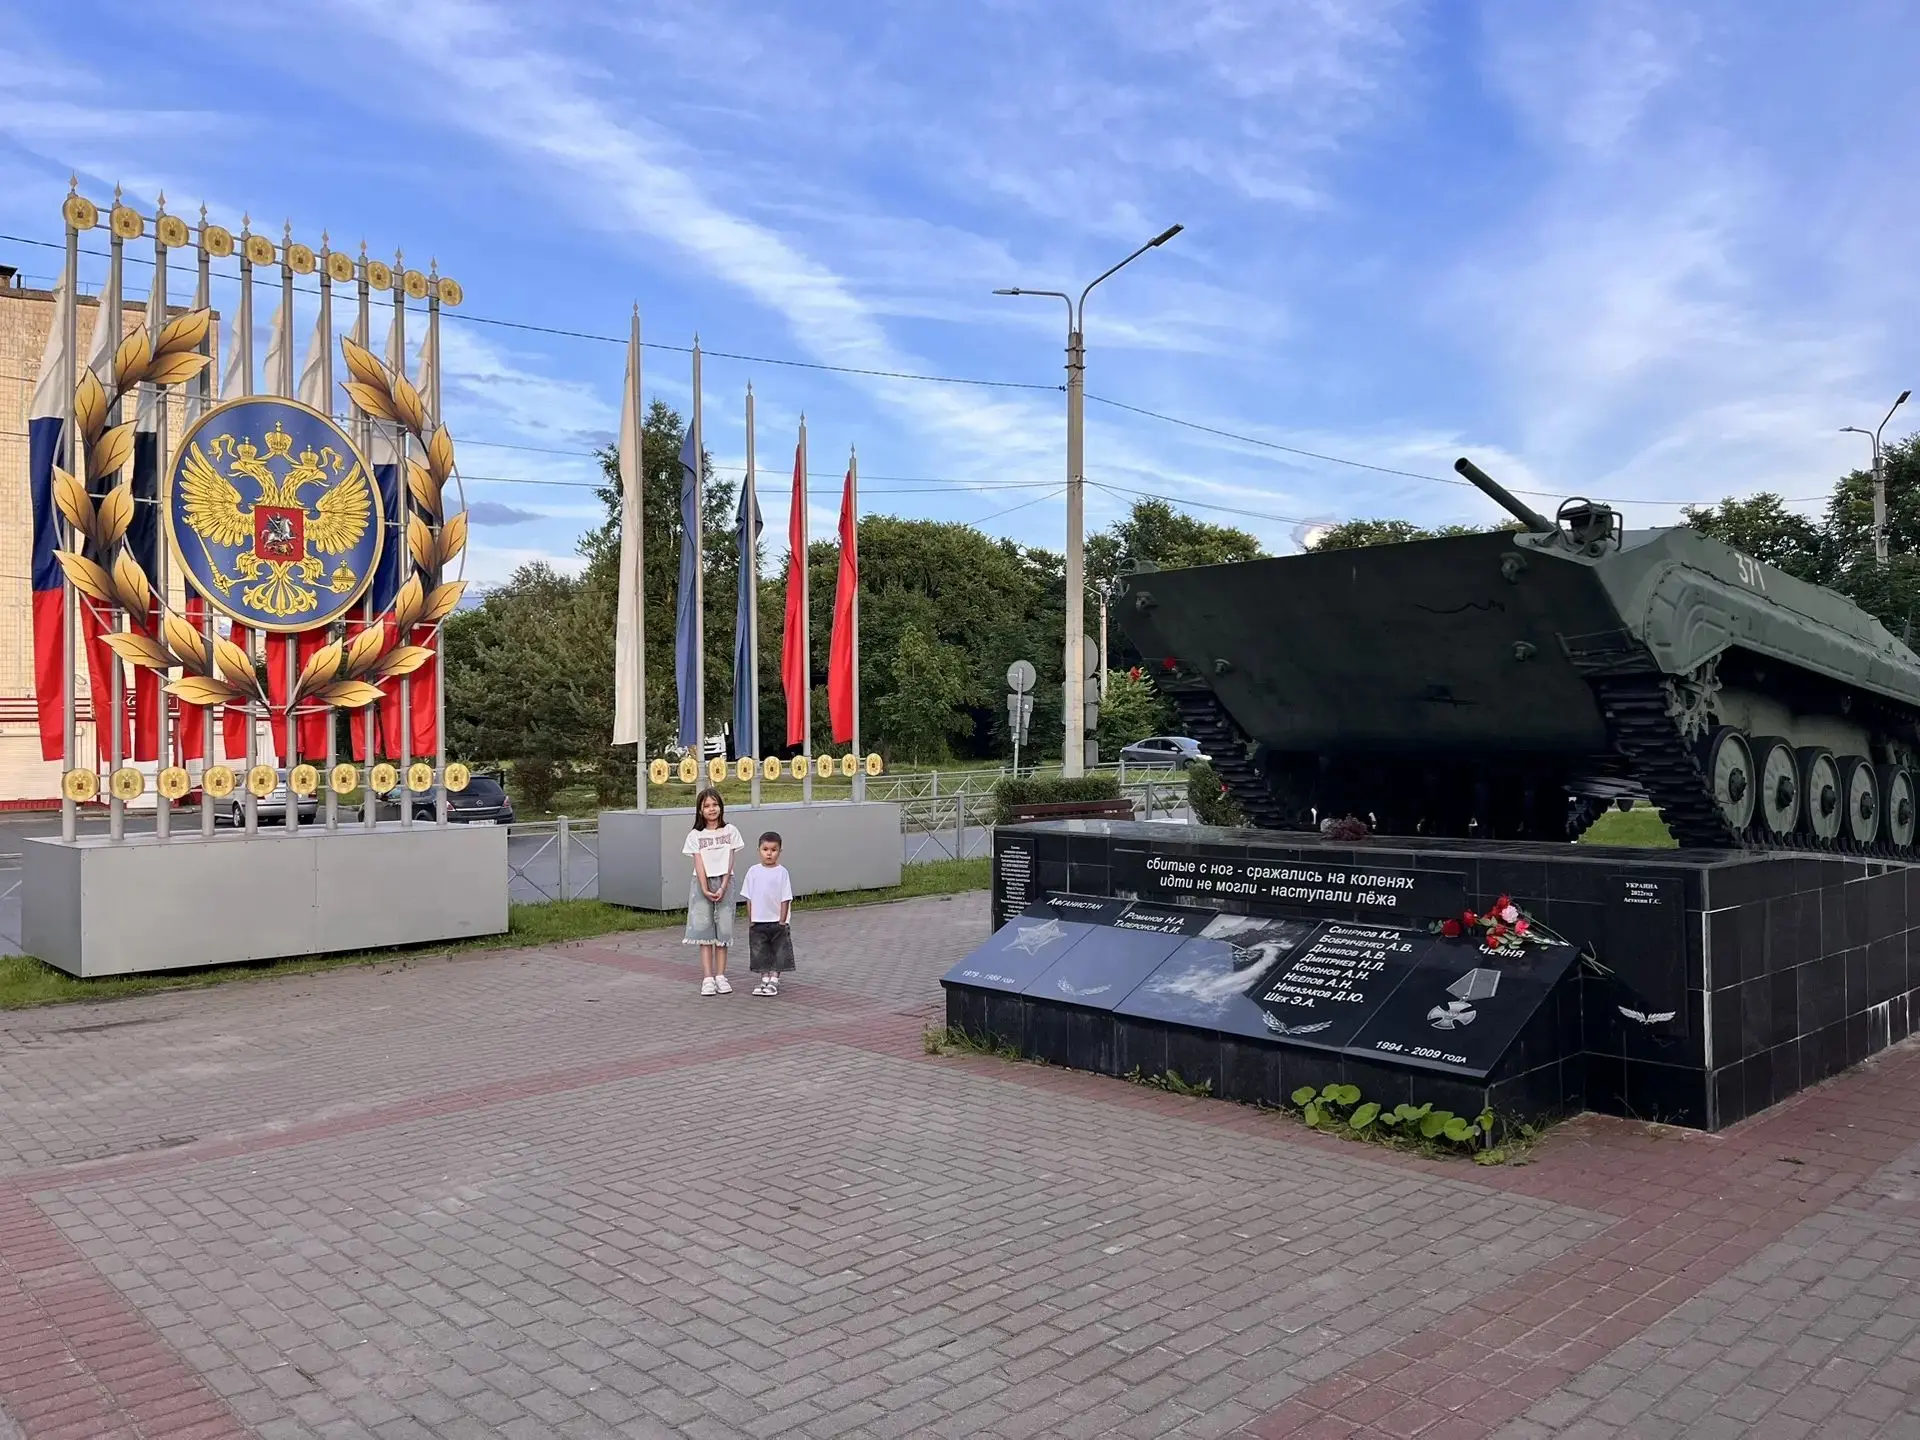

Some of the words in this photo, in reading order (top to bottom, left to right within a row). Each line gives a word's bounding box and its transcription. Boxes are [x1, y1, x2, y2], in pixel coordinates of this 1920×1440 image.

[1734, 552, 1766, 591] 371
[1147, 857, 1195, 873] сбитые
[1200, 863, 1207, 873] с
[1210, 864, 1233, 876] ног
[1246, 865, 1323, 883] сражались
[1327, 873, 1345, 885] на
[1350, 874, 1415, 890] коленях
[1160, 874, 1194, 889] идти
[1197, 878, 1212, 890] не
[1216, 881, 1257, 895] могли
[1270, 884, 1352, 902] наступали
[1356, 891, 1397, 907] лёжа
[1625, 882, 1659, 890] УКРАИНА
[1378, 931, 1401, 940] К.А.
[1385, 942, 1413, 952] А.В.
[1359, 950, 1386, 960] А.В.
[1341, 969, 1369, 980] А.Н.
[1325, 979, 1352, 989] А.Н.
[1290, 996, 1315, 1008] Э.А.
[1331, 991, 1364, 1003] Д.Ю.
[1375, 1040, 1403, 1052] 1994
[1410, 1046, 1442, 1059] 2009
